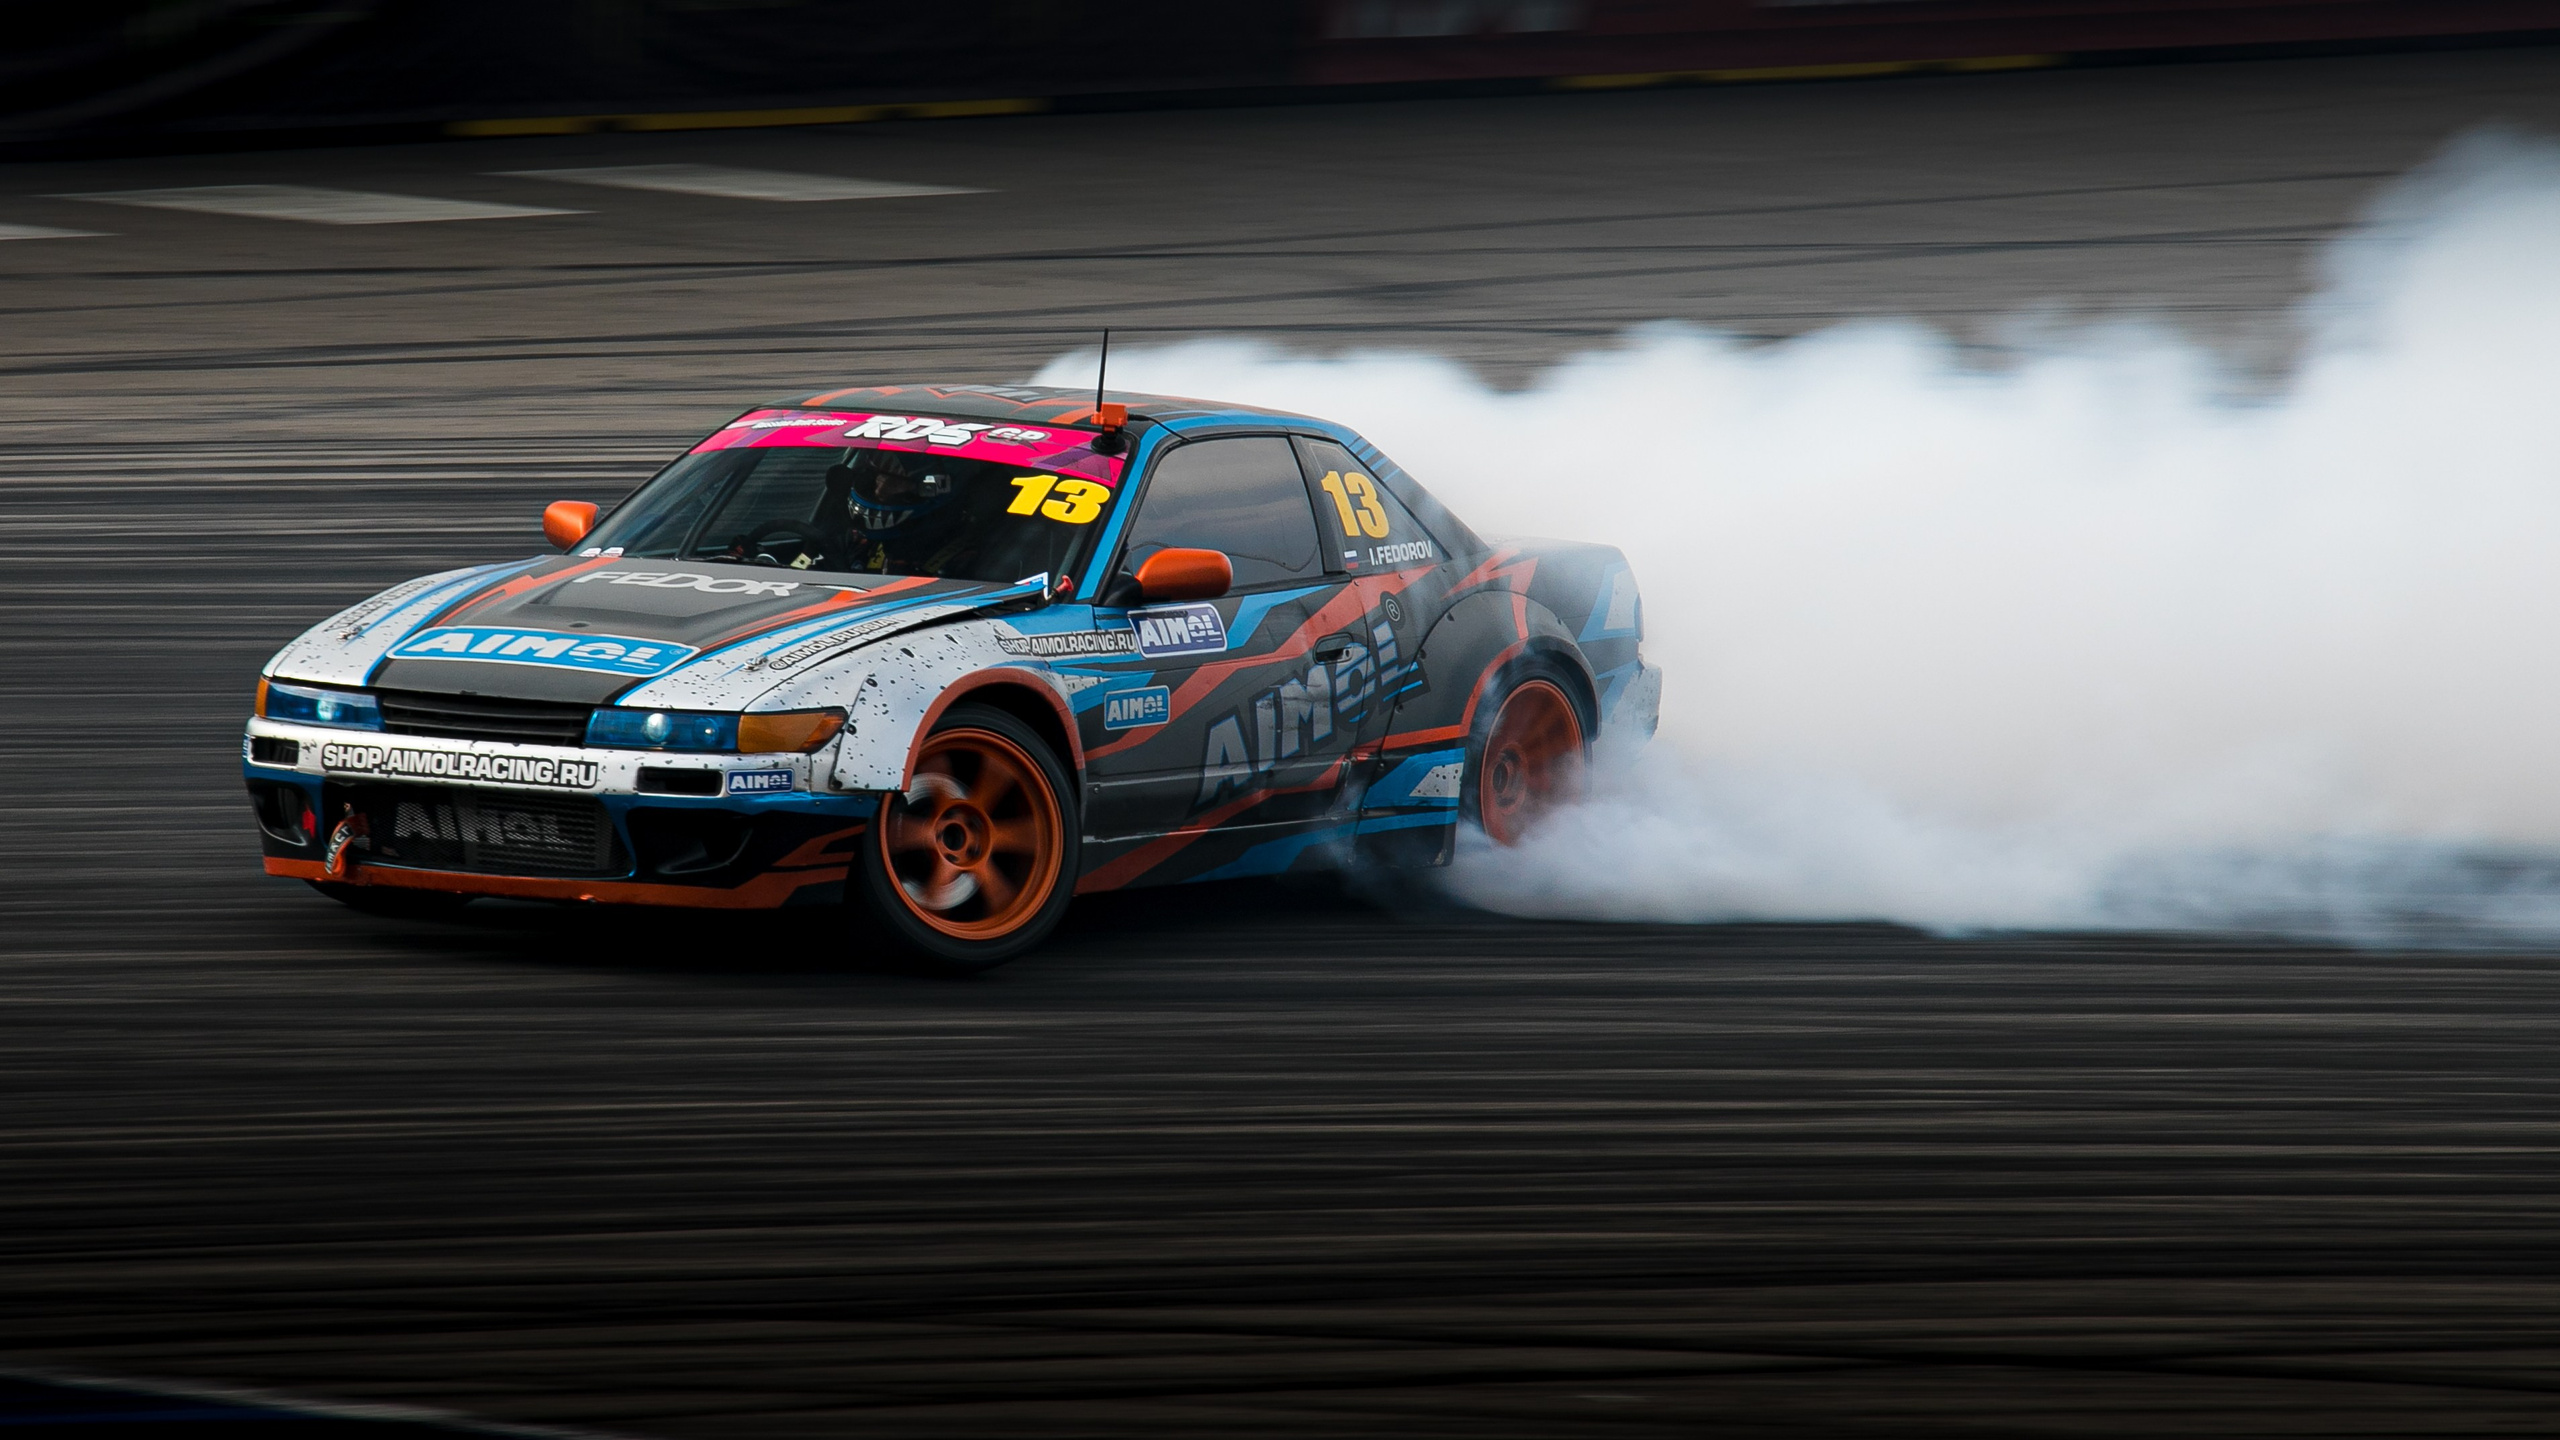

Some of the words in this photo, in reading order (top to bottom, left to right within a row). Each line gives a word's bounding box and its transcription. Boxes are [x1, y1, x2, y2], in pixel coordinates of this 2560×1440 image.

[844, 415, 995, 446] RDS
[1007, 475, 1110, 524] 13
[1321, 471, 1389, 538] 13
[1369, 540, 1433, 566] I.FEDOROV
[572, 572, 799, 597] FEDOR
[1139, 615, 1222, 647] AIMOL
[404, 633, 661, 669] AIMOL
[1107, 695, 1167, 722] AIMOL
[1198, 620, 1423, 803] AIMOL
[323, 745, 597, 786] SHOP.AIMOLRACING.RU
[730, 774, 791, 789] AIMOL
[394, 802, 575, 850] AIMOL
